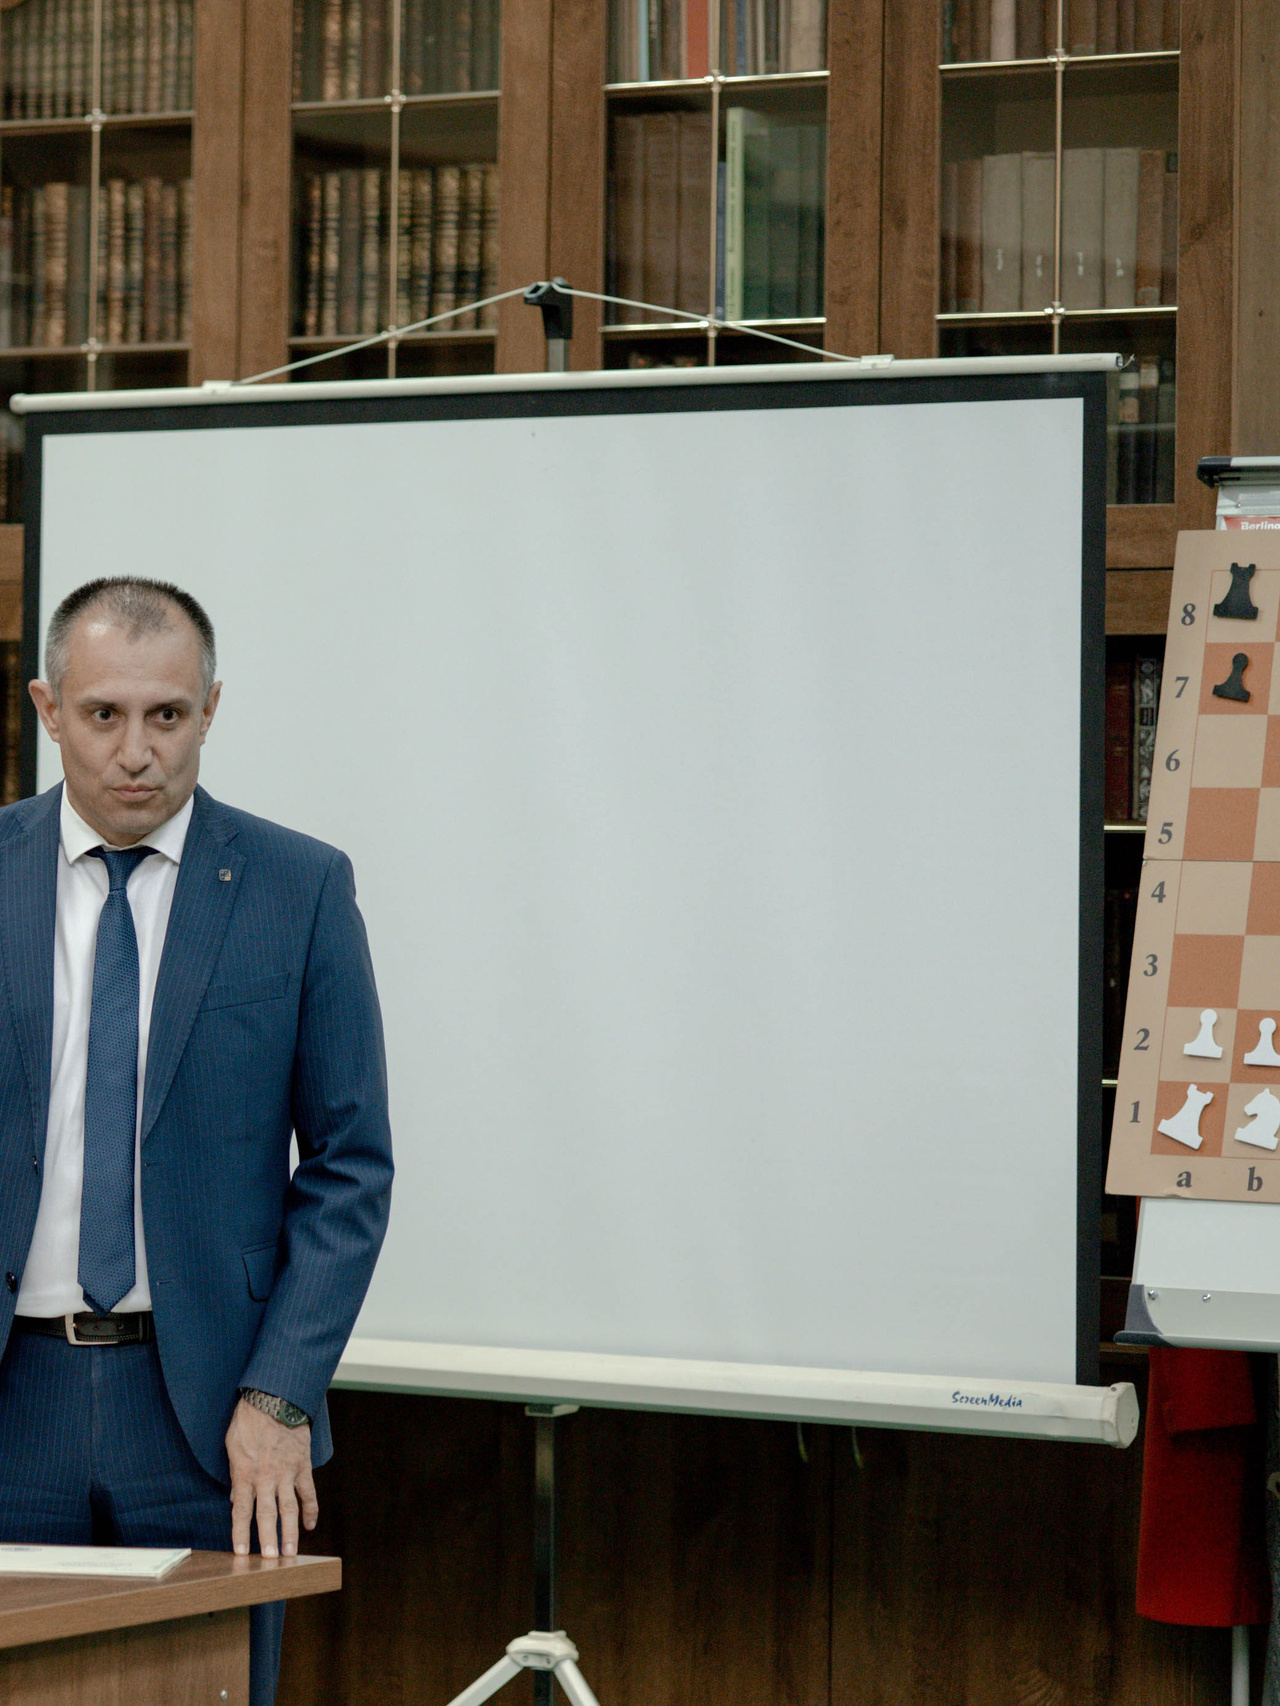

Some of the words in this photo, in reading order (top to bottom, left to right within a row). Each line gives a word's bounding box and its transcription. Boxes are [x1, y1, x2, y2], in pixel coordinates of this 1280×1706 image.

[1180, 602, 1197, 627] 8
[1174, 675, 1190, 699] 7
[1165, 749, 1181, 772] 6
[1157, 821, 1174, 845] 5
[1150, 880, 1167, 904] 4
[1143, 953, 1159, 977] 3
[1133, 1027, 1150, 1051] 2
[1129, 1100, 1141, 1124] 1
[1175, 1170, 1193, 1189] a
[1246, 1166, 1264, 1192] b
[951, 1390, 1023, 1408] ScreenMedia
